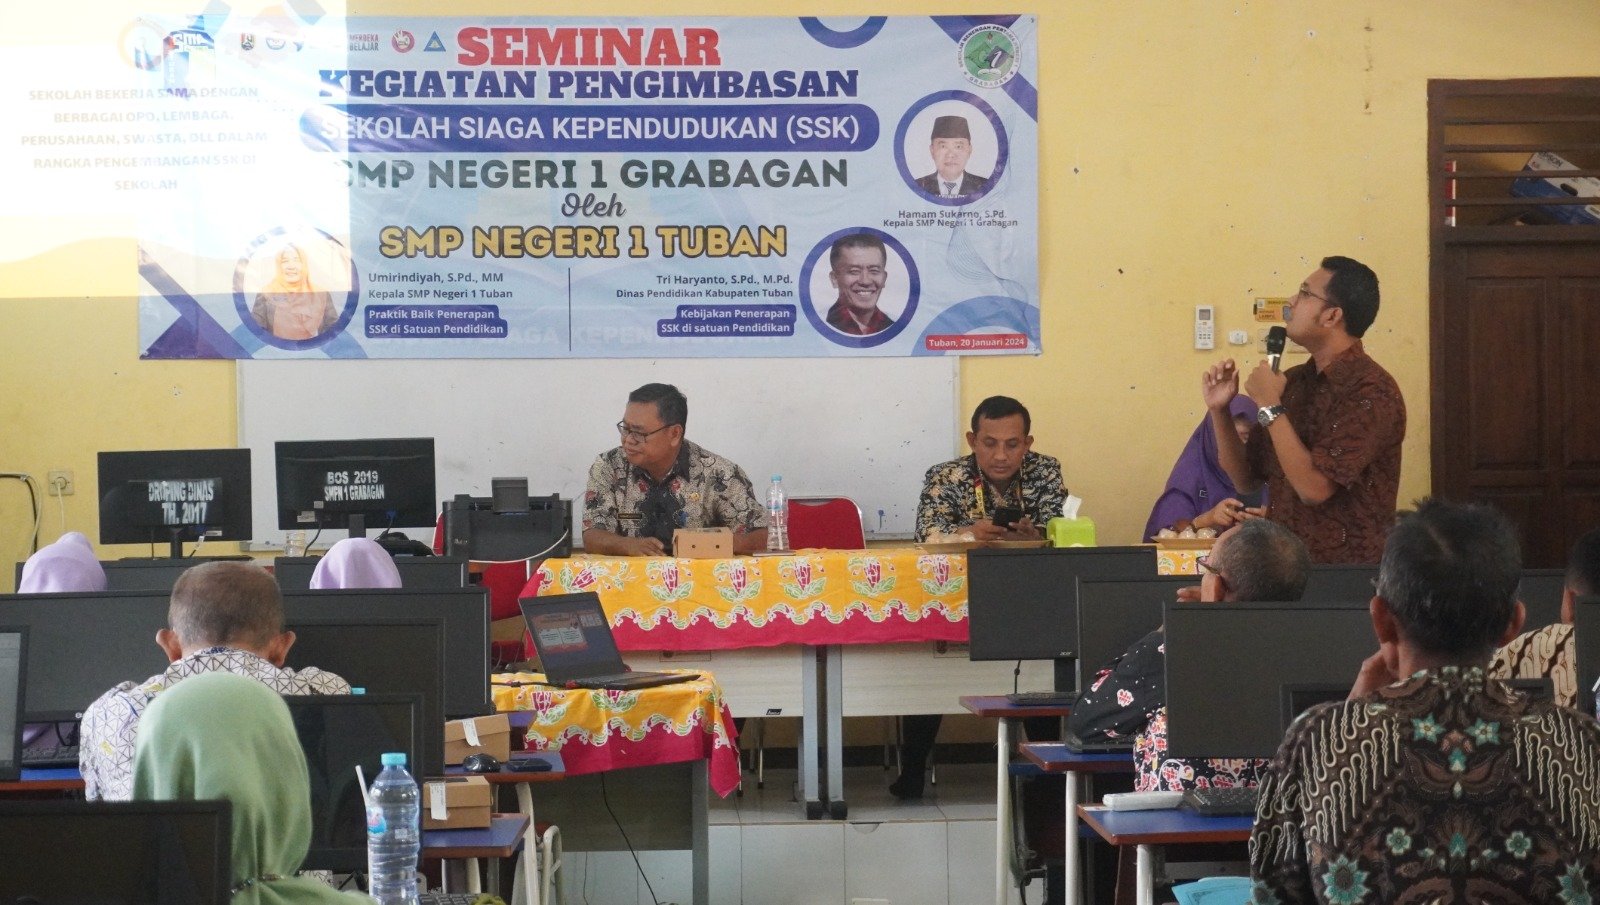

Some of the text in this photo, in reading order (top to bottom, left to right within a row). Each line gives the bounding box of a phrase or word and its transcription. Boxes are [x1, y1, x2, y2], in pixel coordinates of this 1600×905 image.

[349, 42, 379, 51] BELAJAR
[457, 26, 722, 66] SEMINAR
[319, 69, 859, 99] KEGIATAN PENGIMBASAN
[28, 87, 259, 101] SEKOLAH BEKERJA SAMA DENGAN
[53, 112, 123, 124] BERBAGAI
[321, 115, 860, 144] SEKOLAH SIAGA KEPENDUDUKAN (SSK)
[20, 134, 120, 146] PERUSAHAAN,
[189, 132, 215, 143] DLL
[217, 131, 268, 143] DALAM
[33, 157, 92, 169] RANGKA
[428, 159, 577, 189] NEGERI
[591, 159, 608, 189] 1
[619, 158, 848, 189] GRABAGAN
[114, 179, 178, 191] SEKOLAH
[560, 192, 627, 218] Oleh
[898, 209, 1007, 220] Hamam Sukarno, S.Pd.
[883, 218, 1018, 229] Kepala SMP Negeri 1 Grabagan
[378, 224, 788, 259] SMP NEGERI 1 TUBAN
[368, 272, 504, 285] Umirindiyah, S.Pd., MM
[656, 274, 793, 287] Tri Haryanto, S.Pd., M.Pd.
[368, 289, 513, 301] Kepala SMP Negeri 1 Tuban
[616, 288, 793, 300] Dinas Pendidikan Kabupaten Tuban
[368, 309, 495, 321] Praktik Baik Penerapan
[681, 309, 790, 320] Kebijakan Penerapan
[368, 324, 504, 334] SSK di Satuan Pendidikan
[661, 322, 790, 333] SSK di satuan Pendidikan
[929, 338, 1025, 348] Tuban, 20 Januari 2024
[326, 469, 379, 484] BOS 2019
[187, 479, 214, 501] DINAS
[324, 484, 385, 501] SMPN 1 GRABAGAN
[161, 501, 208, 525] TH. 2017
